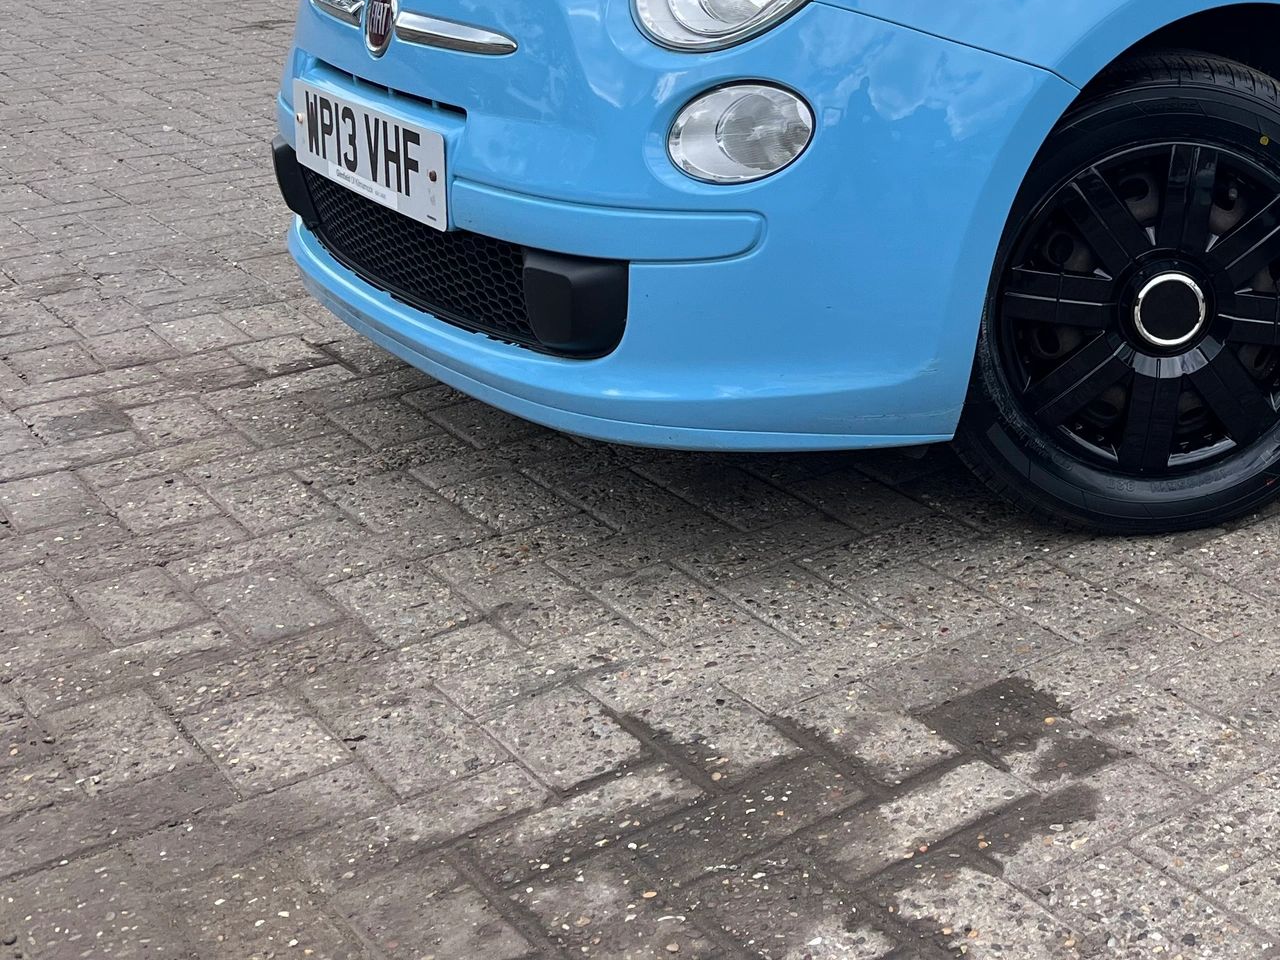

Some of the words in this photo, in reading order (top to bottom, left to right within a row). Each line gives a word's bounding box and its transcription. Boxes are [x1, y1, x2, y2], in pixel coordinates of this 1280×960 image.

[367, 1, 390, 35] FIAT
[305, 90, 358, 173] WP13
[363, 112, 421, 197] VHF
